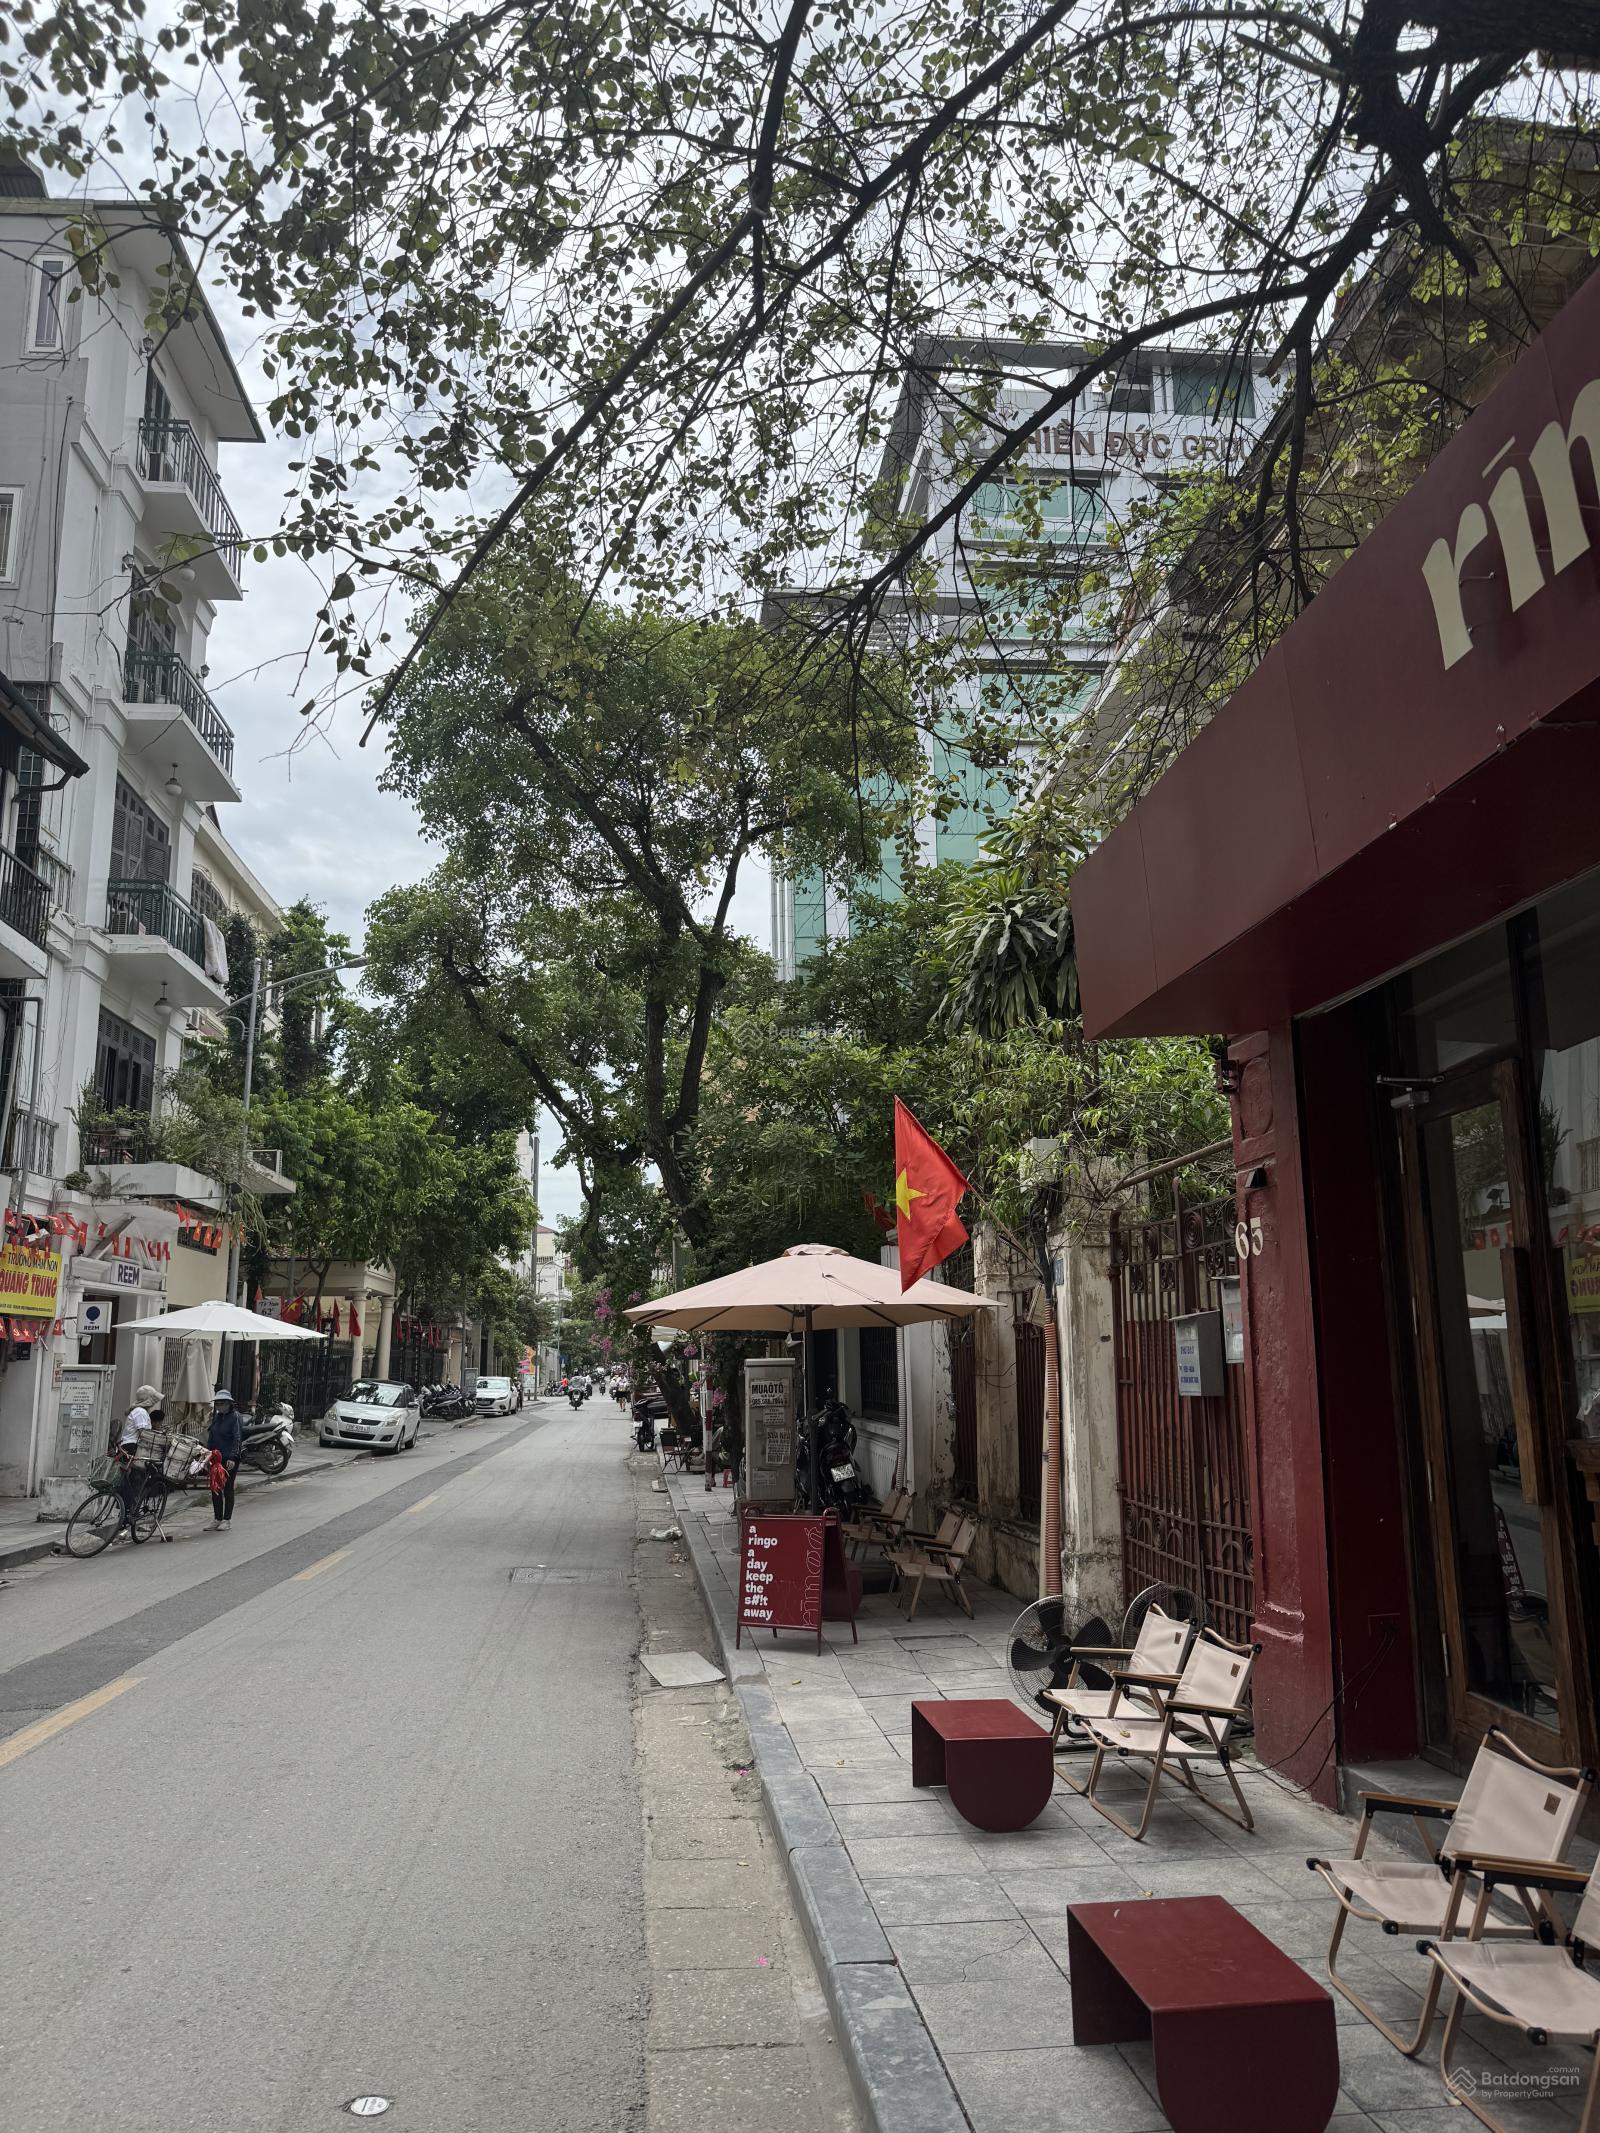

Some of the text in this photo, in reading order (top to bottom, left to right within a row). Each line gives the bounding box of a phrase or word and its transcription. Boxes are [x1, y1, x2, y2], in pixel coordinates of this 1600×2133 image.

[1235, 1216, 1263, 1259] 65
[118, 1264, 140, 1286] REEM
[749, 1525, 756, 1533] a
[748, 1534, 778, 1548] ringo
[747, 1549, 755, 1557] a
[747, 1558, 768, 1572] day
[745, 1570, 773, 1584] keep
[745, 1582, 764, 1593] the
[744, 1594, 768, 1606] s#!t
[743, 1608, 773, 1621] away
